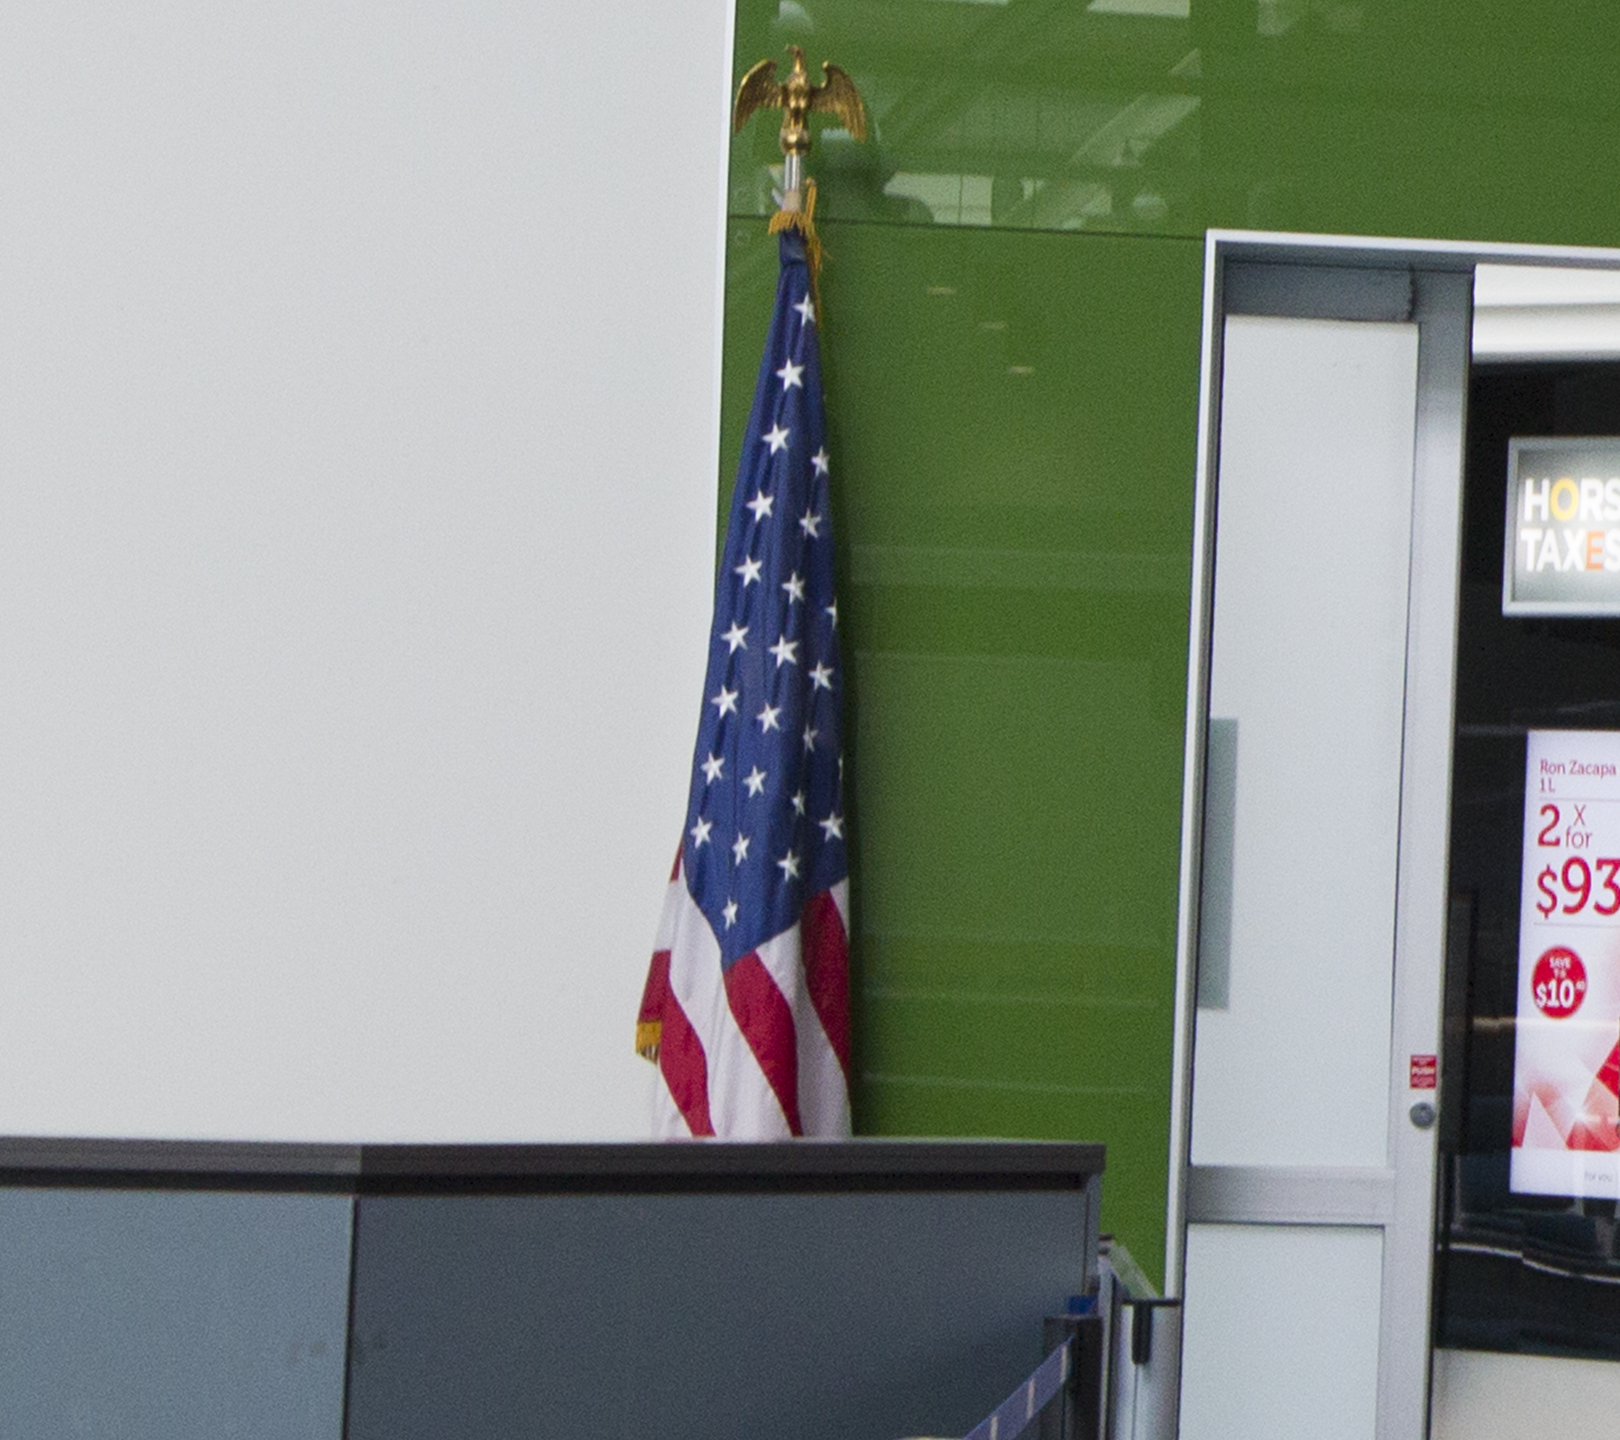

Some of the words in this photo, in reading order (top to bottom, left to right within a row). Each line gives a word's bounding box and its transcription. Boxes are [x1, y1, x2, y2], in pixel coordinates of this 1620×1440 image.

[1540, 759, 1565, 775] Ron
[1568, 759, 1616, 779] Zacapa
[1537, 803, 1561, 847] 2
[1566, 826, 1592, 848] for
